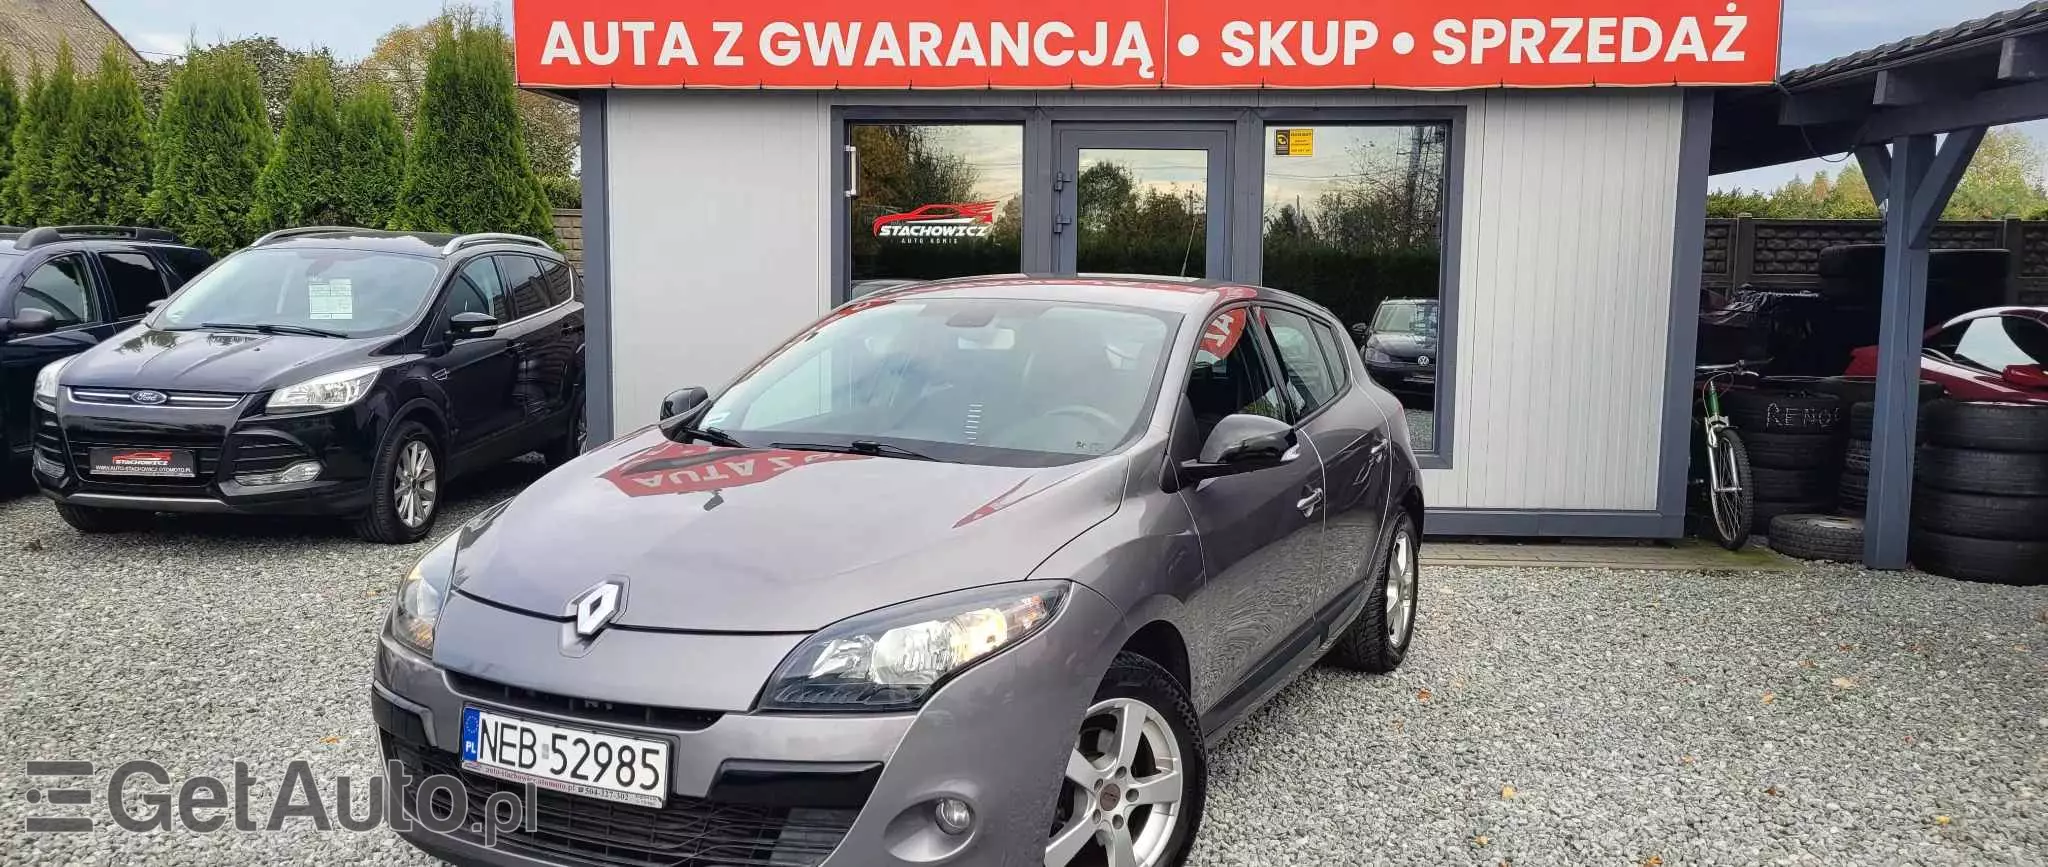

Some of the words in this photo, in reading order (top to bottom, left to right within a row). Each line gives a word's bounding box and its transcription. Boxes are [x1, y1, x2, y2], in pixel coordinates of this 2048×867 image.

[541, 21, 698, 66] AUTA
[712, 21, 744, 66] Z
[759, 21, 1154, 79] GWARANCJĄ
[1221, 20, 1379, 67] SKUP
[1433, 2, 1747, 65] SPRZEDAŻ
[879, 225, 988, 236] STACHOWICZ
[465, 741, 477, 754] PL
[480, 718, 538, 769] NEB
[549, 733, 660, 791] 52985
